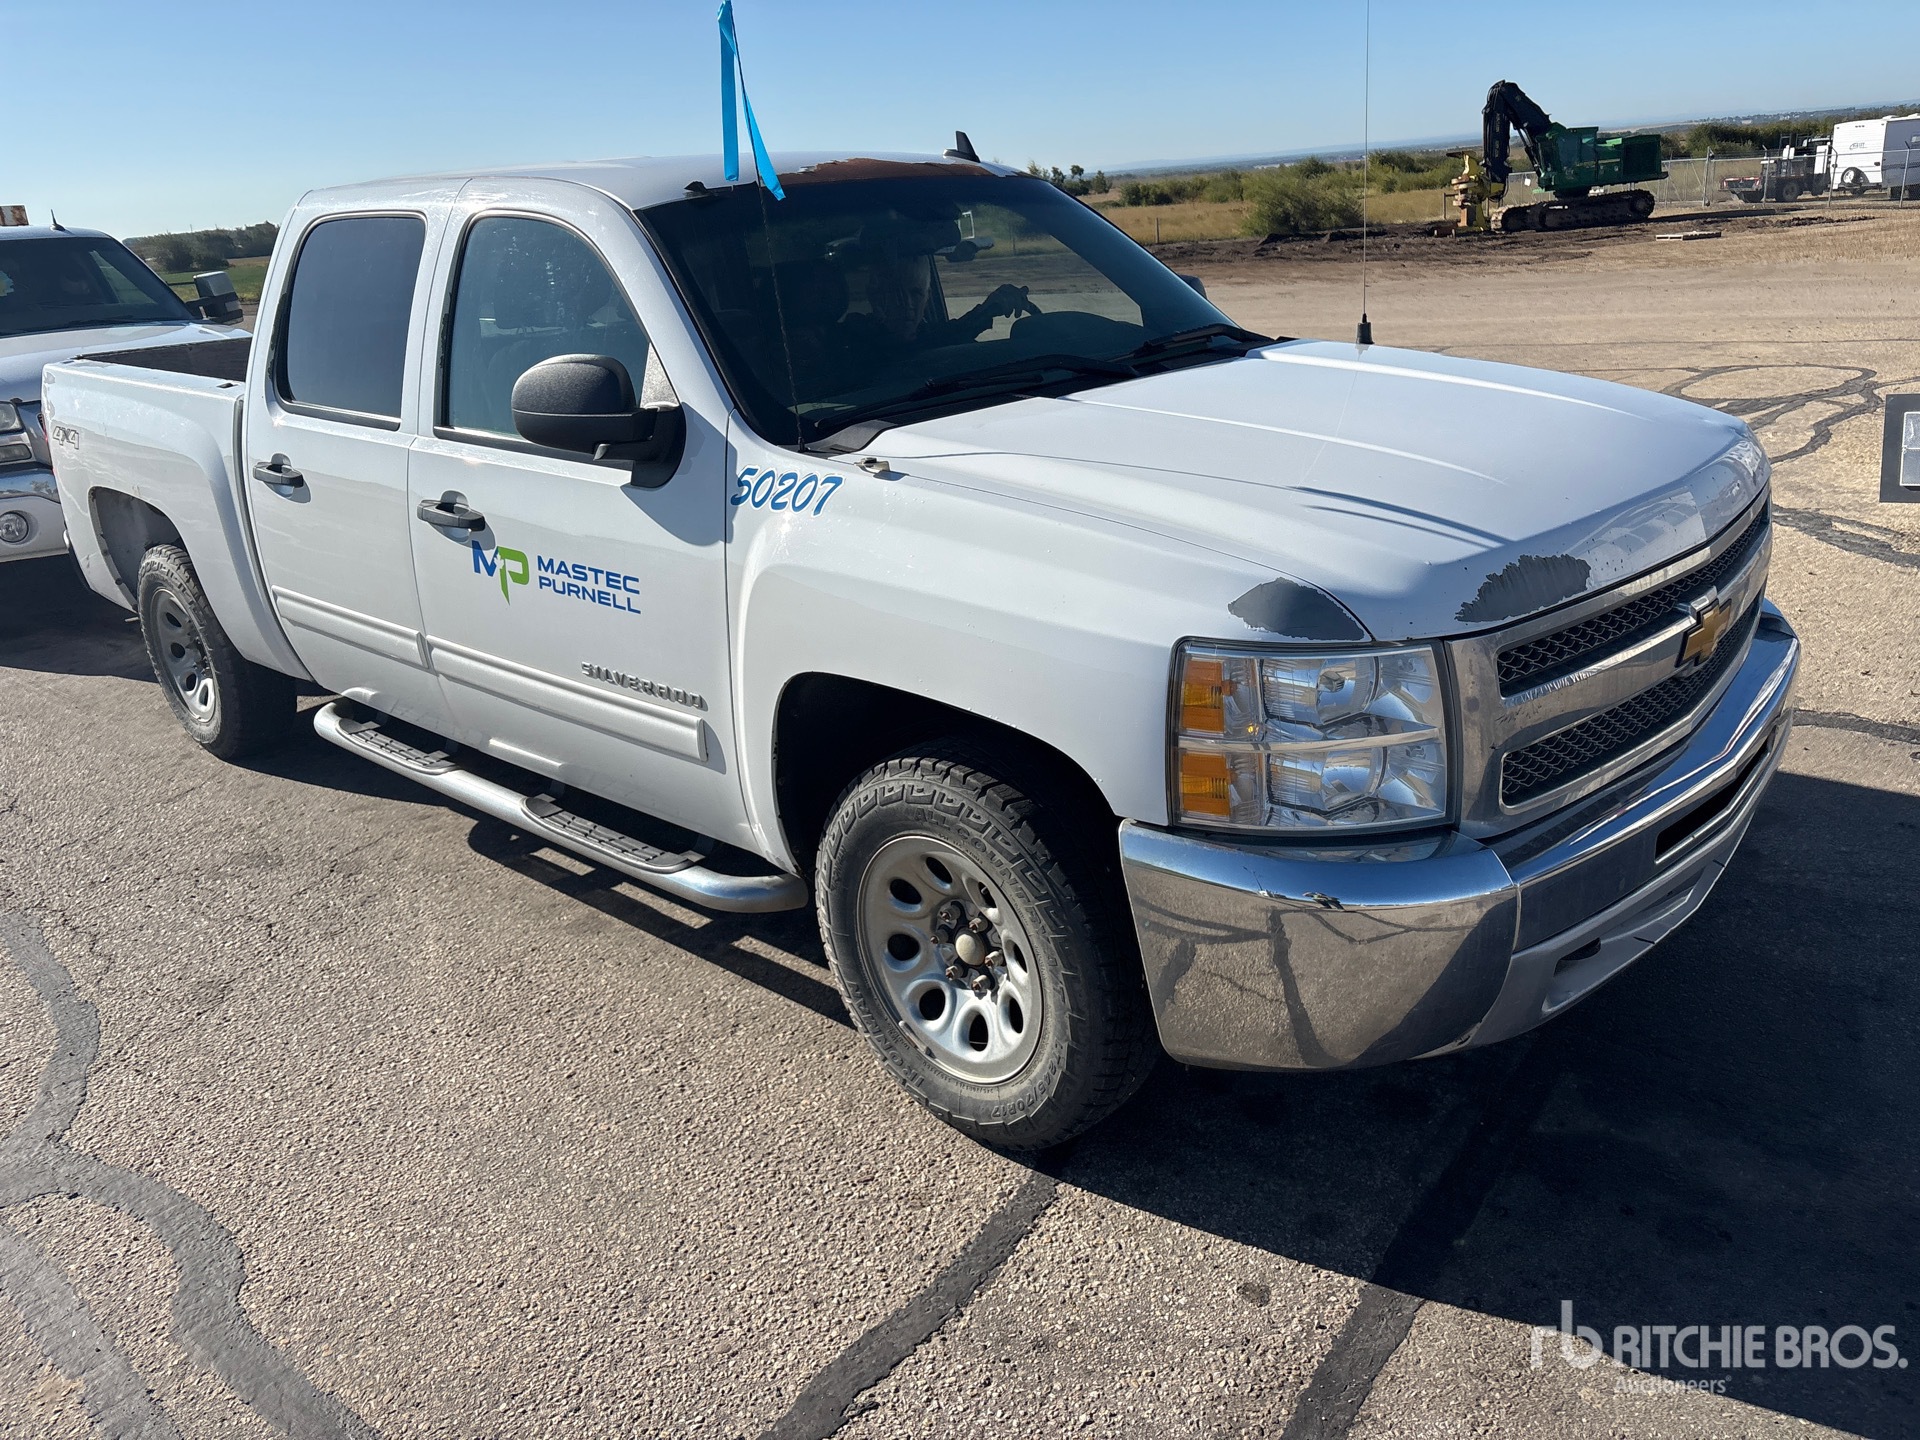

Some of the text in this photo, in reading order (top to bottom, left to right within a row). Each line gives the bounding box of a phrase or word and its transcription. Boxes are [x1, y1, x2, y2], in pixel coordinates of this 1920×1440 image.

[730, 466, 845, 517] 50207
[537, 554, 641, 595] MASTEC
[538, 575, 642, 615] PURNELL
[580, 660, 706, 711] SILVERADO
[849, 978, 926, 1088] IRONMAN
